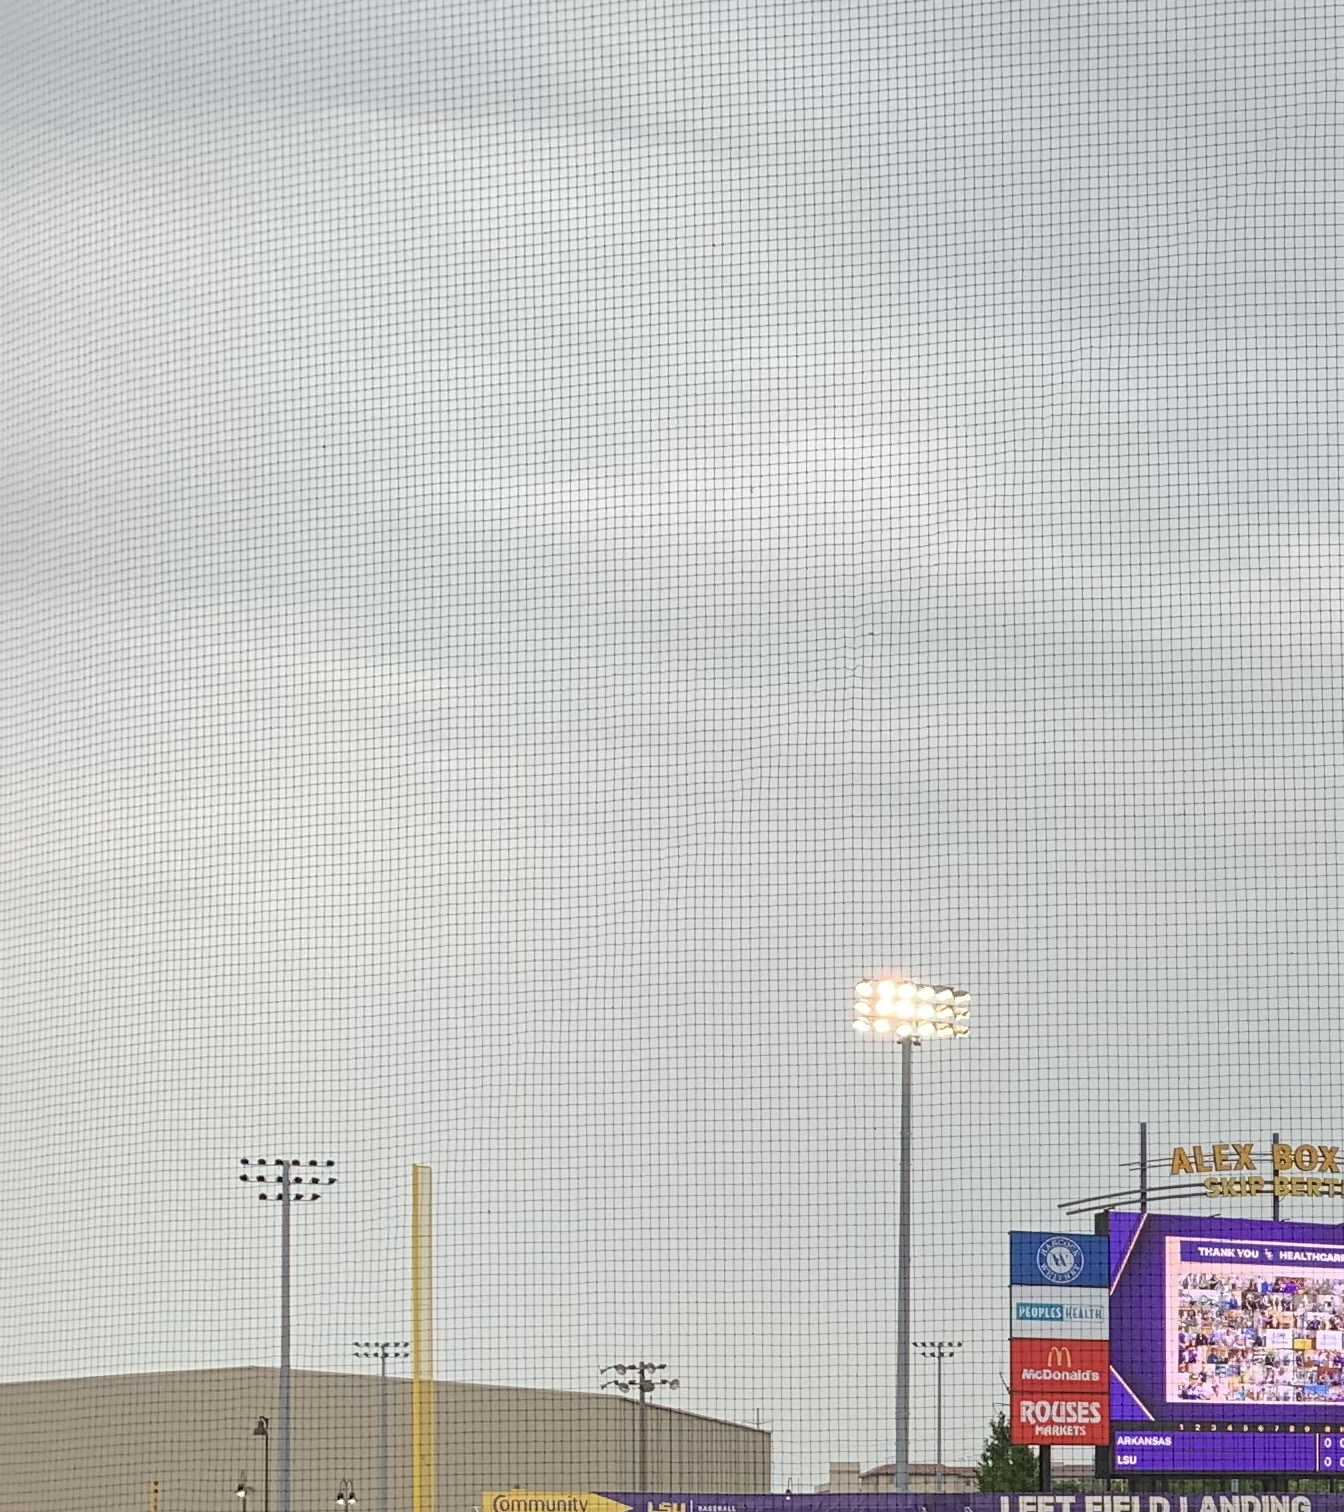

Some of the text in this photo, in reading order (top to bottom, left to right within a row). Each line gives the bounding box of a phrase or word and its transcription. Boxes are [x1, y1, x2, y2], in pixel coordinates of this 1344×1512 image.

[1170, 1143, 1255, 1175] ALEX
[1272, 1143, 1340, 1173] BOX
[1203, 1176, 1265, 1198] SKIP
[1198, 1247, 1235, 1258] THANK
[1237, 1248, 1259, 1259] YOU
[1019, 1303, 1103, 1321] PEOPLES HEALTH
[1022, 1368, 1099, 1381] McDonald's
[1020, 1400, 1101, 1425] ROUSES
[1035, 1425, 1087, 1437] MARKETS
[1117, 1436, 1172, 1446] ARKANSAS
[1324, 1438, 1332, 1448] 0
[1117, 1455, 1137, 1465] LSU
[1324, 1457, 1332, 1467] 0
[698, 1505, 737, 1512] BASEBALL
